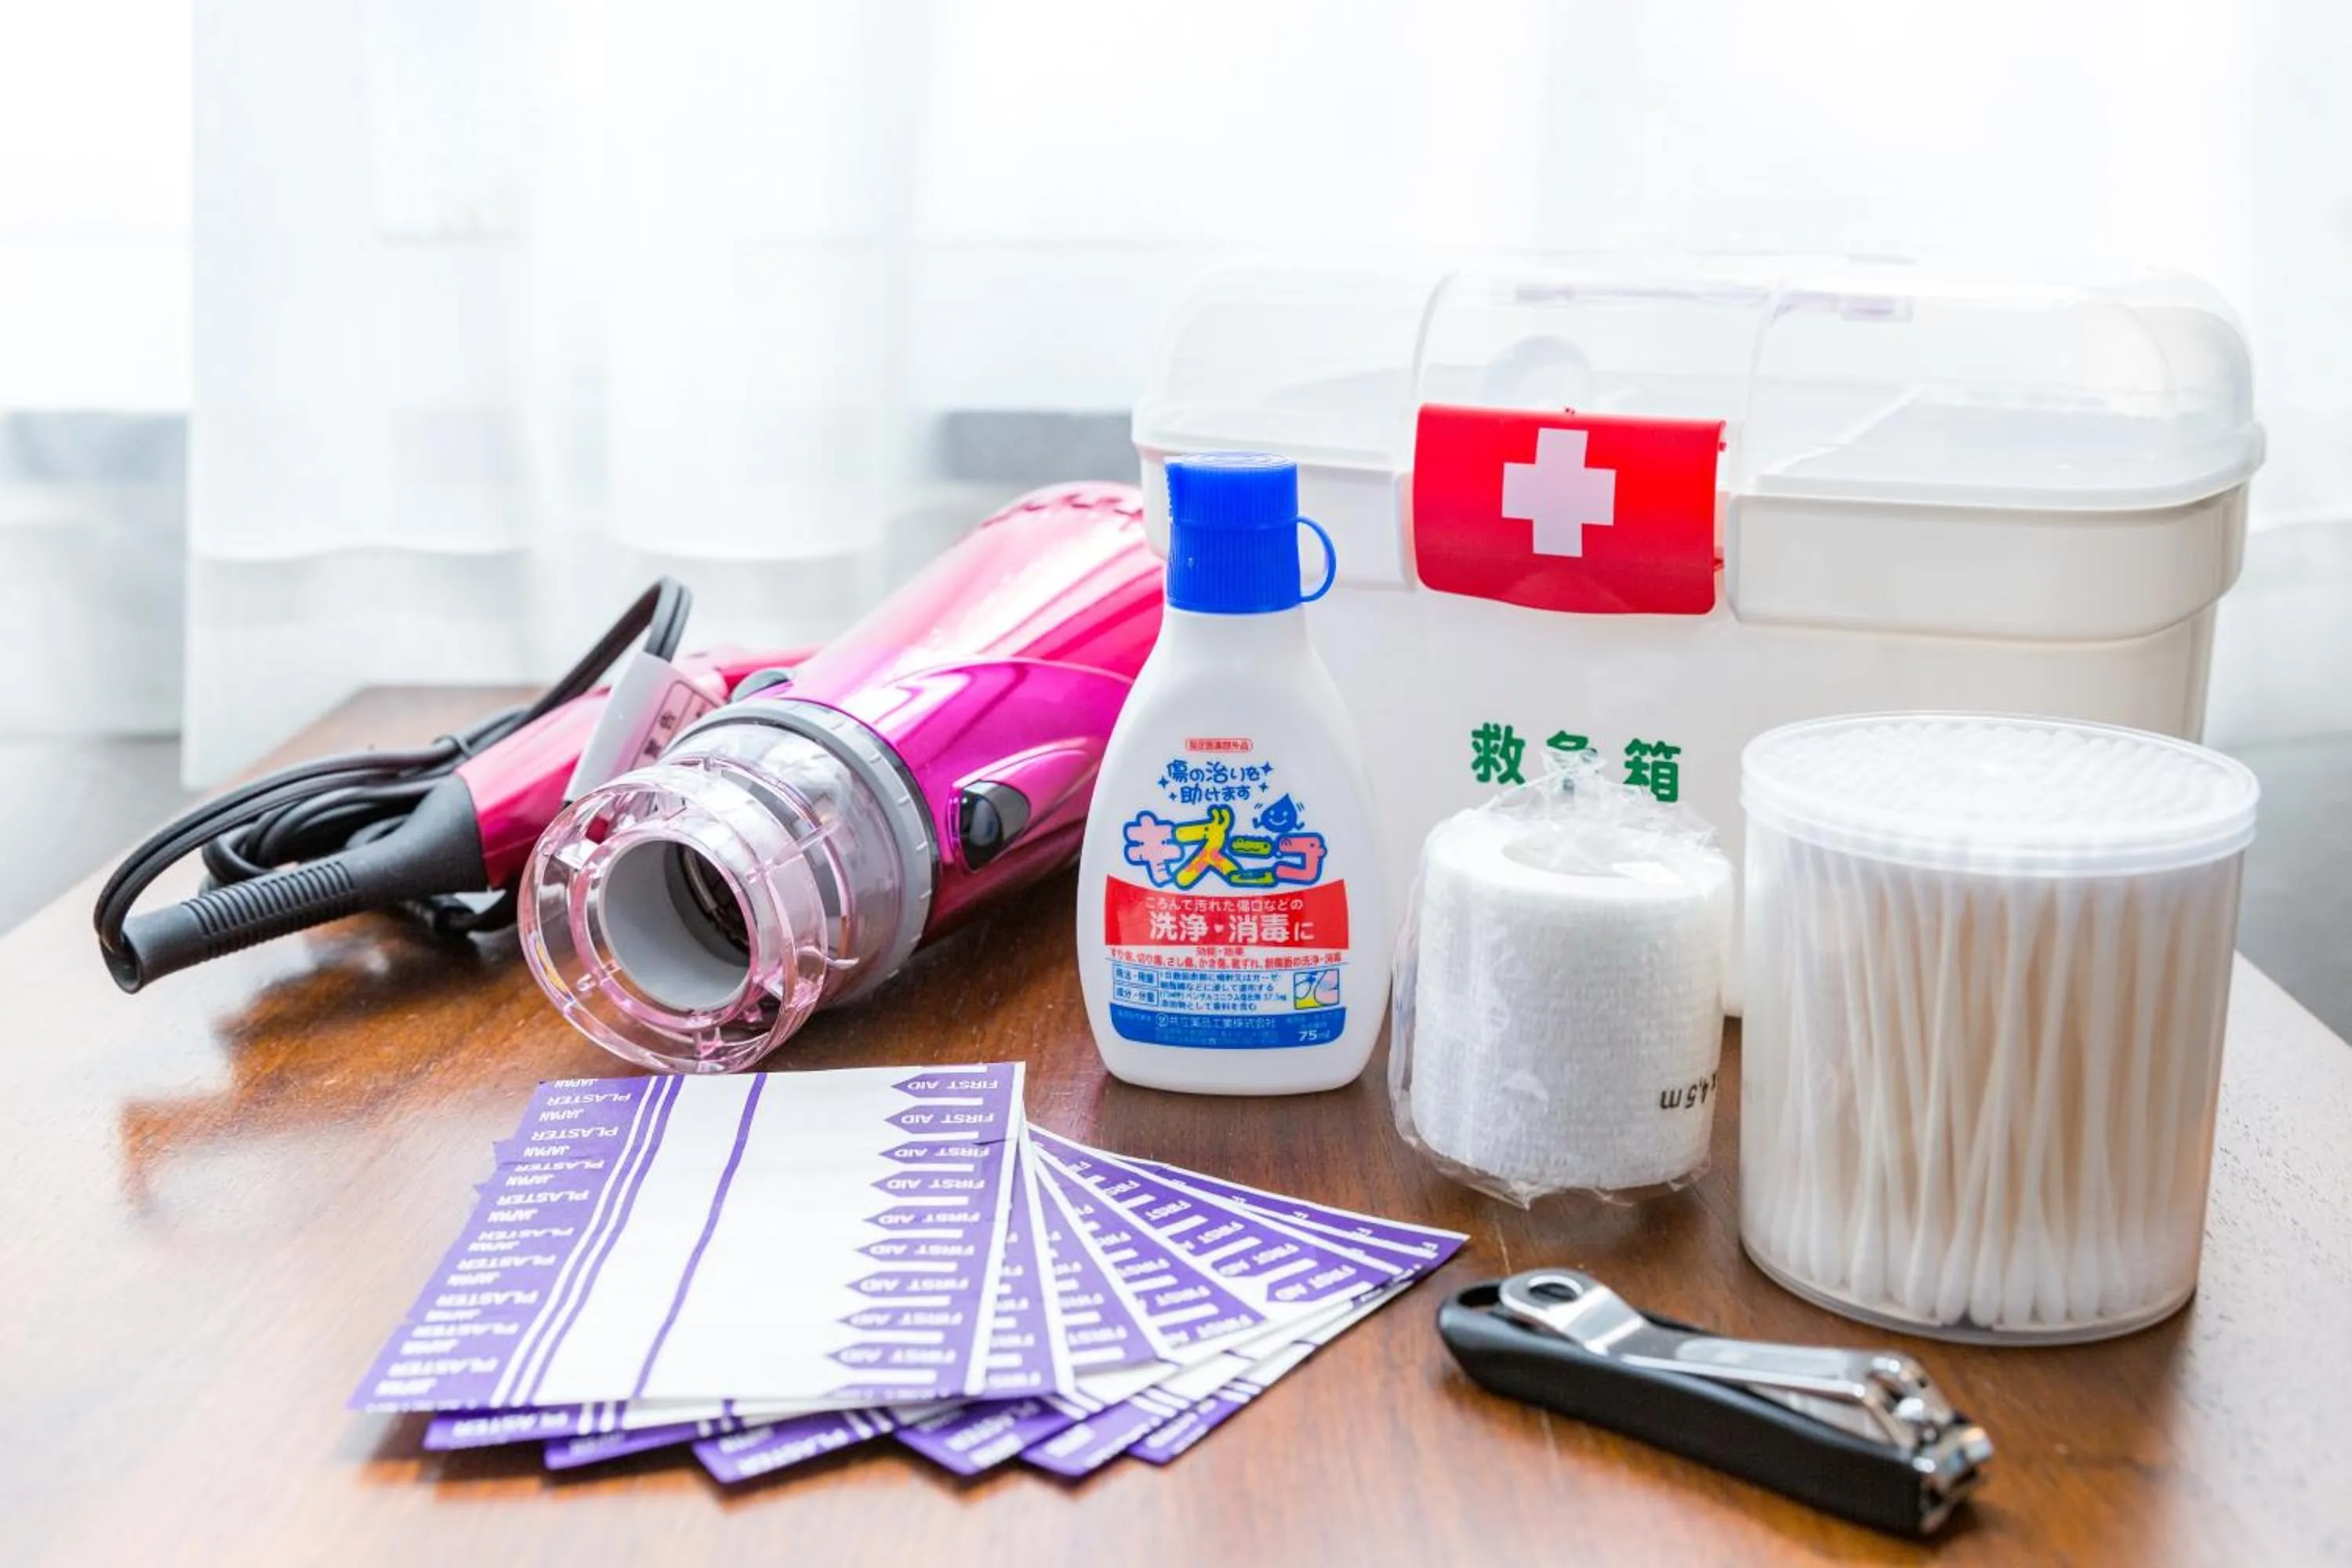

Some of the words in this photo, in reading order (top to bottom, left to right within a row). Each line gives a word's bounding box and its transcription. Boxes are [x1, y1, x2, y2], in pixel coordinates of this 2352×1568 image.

[1167, 759, 1260, 783] 傷の治りを
[1180, 783, 1250, 805] 助けます
[907, 1080, 940, 1090] AID
[946, 1080, 999, 1089] FIRST
[546, 1093, 632, 1106] PLASTER
[539, 1109, 584, 1122] JAPAN
[901, 1113, 935, 1123] AID
[940, 1113, 995, 1123] FIRST
[531, 1127, 619, 1141] PLASTER
[524, 1145, 570, 1157] JAPAN
[894, 1148, 928, 1158] AID
[935, 1147, 991, 1157] FIRST
[514, 1160, 604, 1171] PLASTER
[506, 1174, 555, 1187] JAPAN
[886, 1178, 922, 1189] AID
[928, 1178, 986, 1189] FIRST
[496, 1189, 590, 1206] PLASTER
[1145, 1199, 1191, 1220] FIRST
[877, 1214, 916, 1225] AID
[921, 1212, 981, 1223] FIRST
[477, 1227, 575, 1241] PLASTER
[1196, 1221, 1244, 1243] FIRST
[456, 1255, 557, 1271] PLASTER
